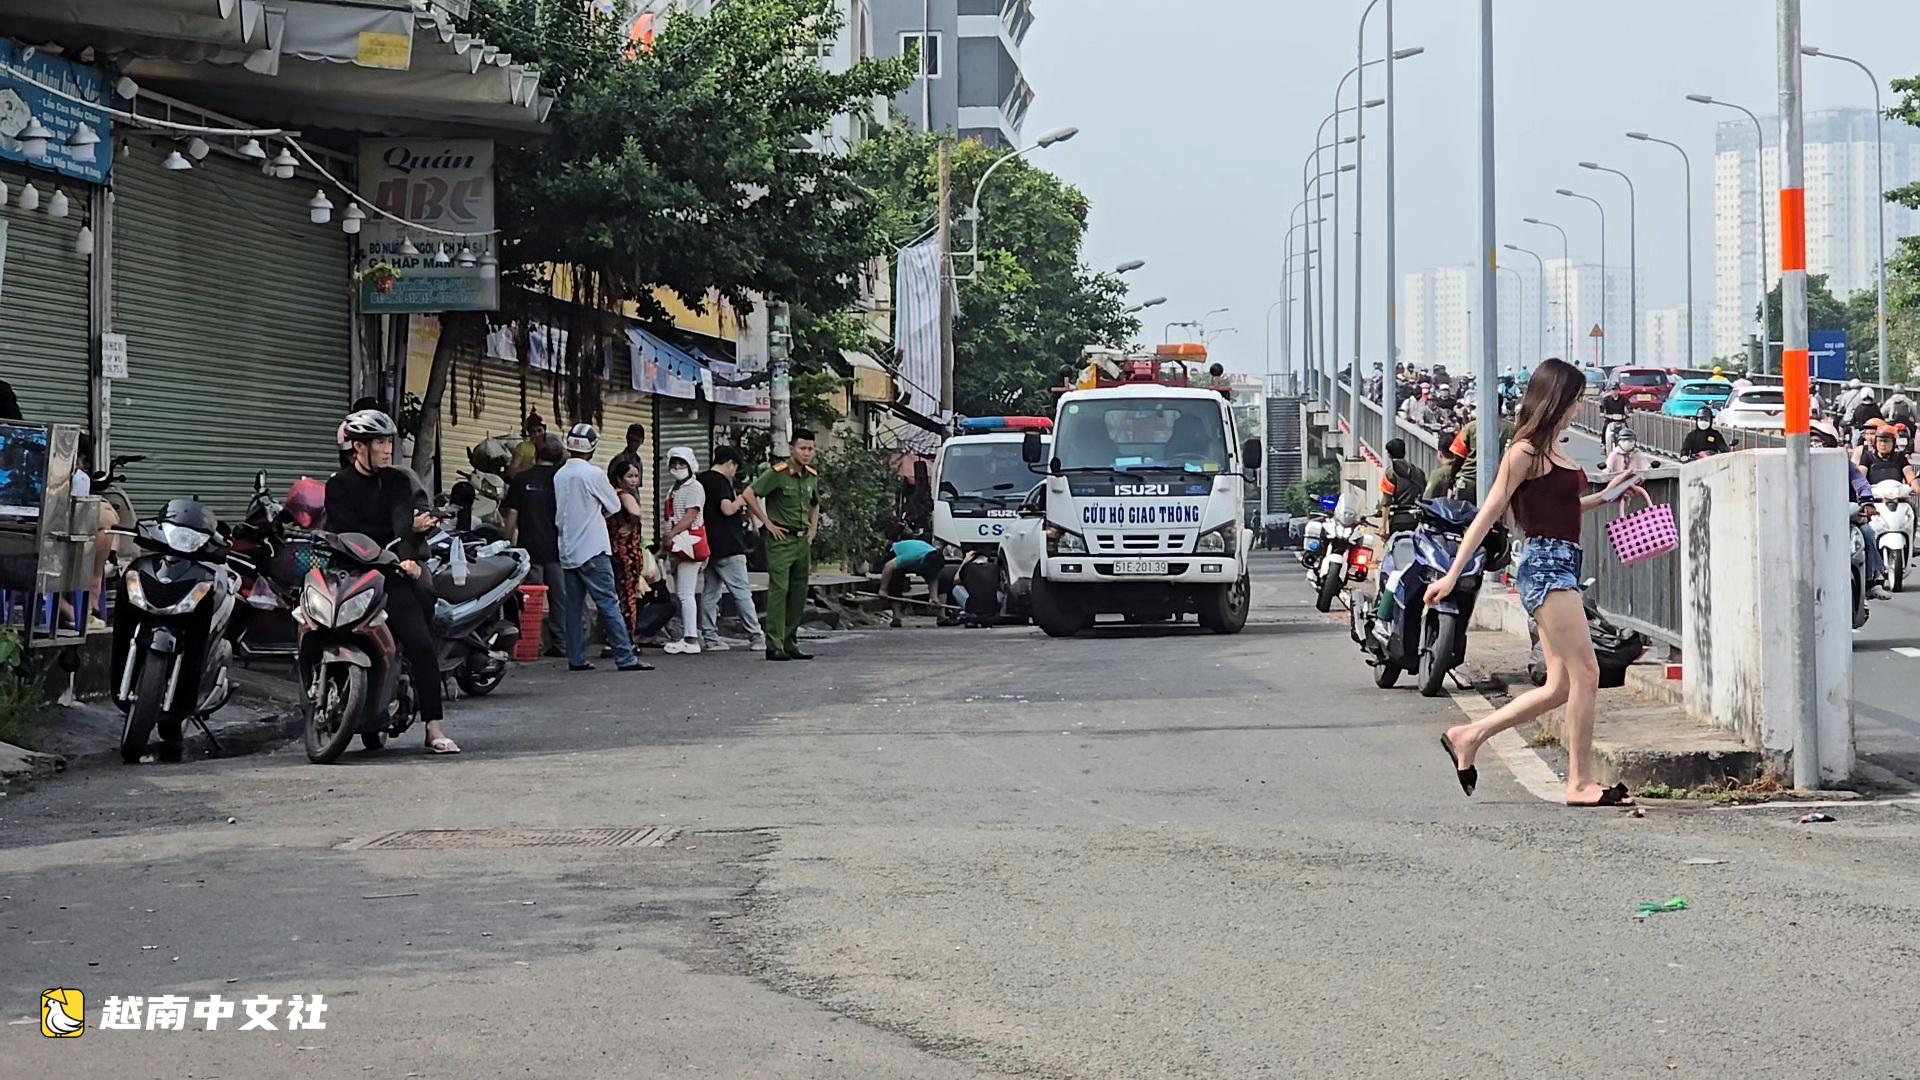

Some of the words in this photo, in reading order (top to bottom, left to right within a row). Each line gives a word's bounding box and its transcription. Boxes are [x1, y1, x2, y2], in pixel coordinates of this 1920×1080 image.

[383, 147, 474, 174] Quán
[372, 176, 485, 222] ABC
[1114, 484, 1169, 495] ISUZU
[1083, 502, 1106, 523] CỨU
[1109, 502, 1125, 528] HỘ
[1128, 506, 1156, 523] GIAO
[1159, 501, 1199, 523] THÔNG
